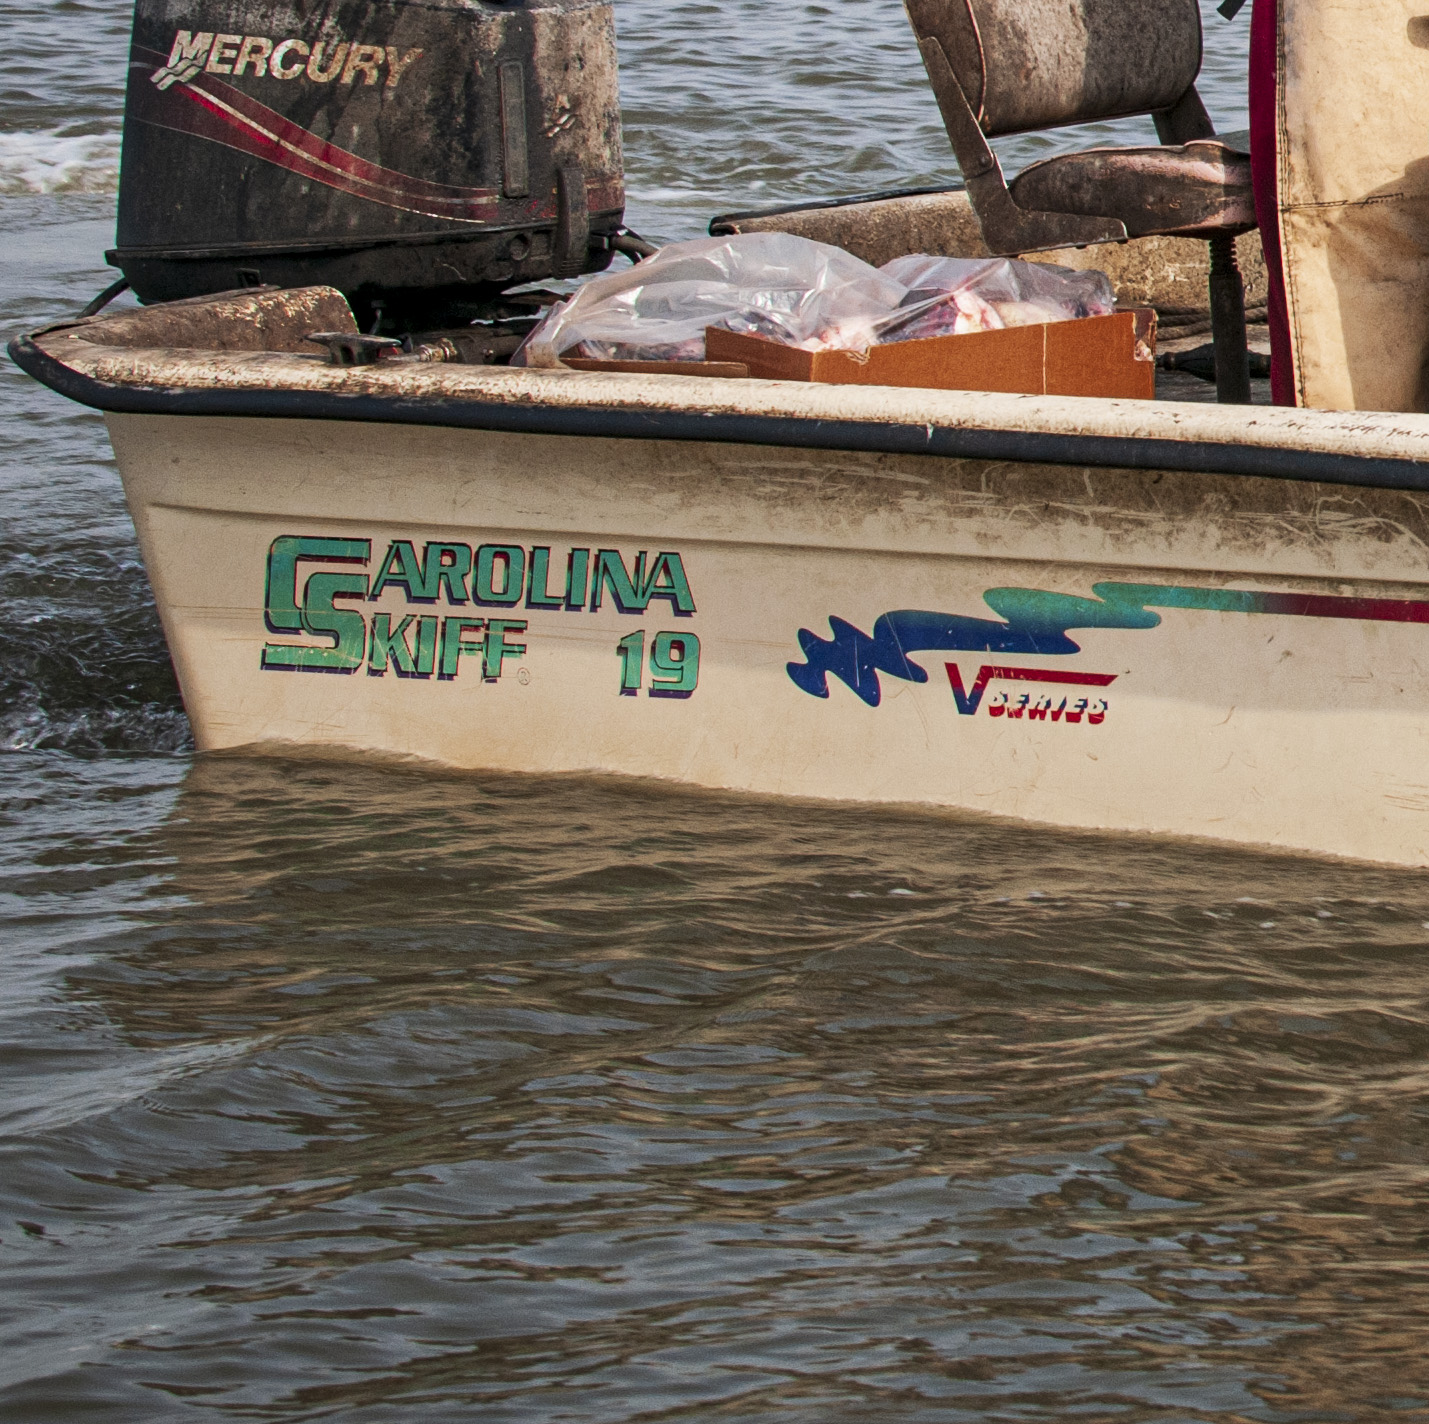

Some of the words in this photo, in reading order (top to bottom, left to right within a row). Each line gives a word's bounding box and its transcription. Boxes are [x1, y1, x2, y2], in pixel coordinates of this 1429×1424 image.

[150, 29, 424, 90] MERCURY
[264, 534, 698, 634] CAROLINA
[260, 571, 529, 683] SKIFF
[616, 629, 701, 699] 19
[944, 662, 991, 716] V
[988, 691, 1109, 725] SERIES
